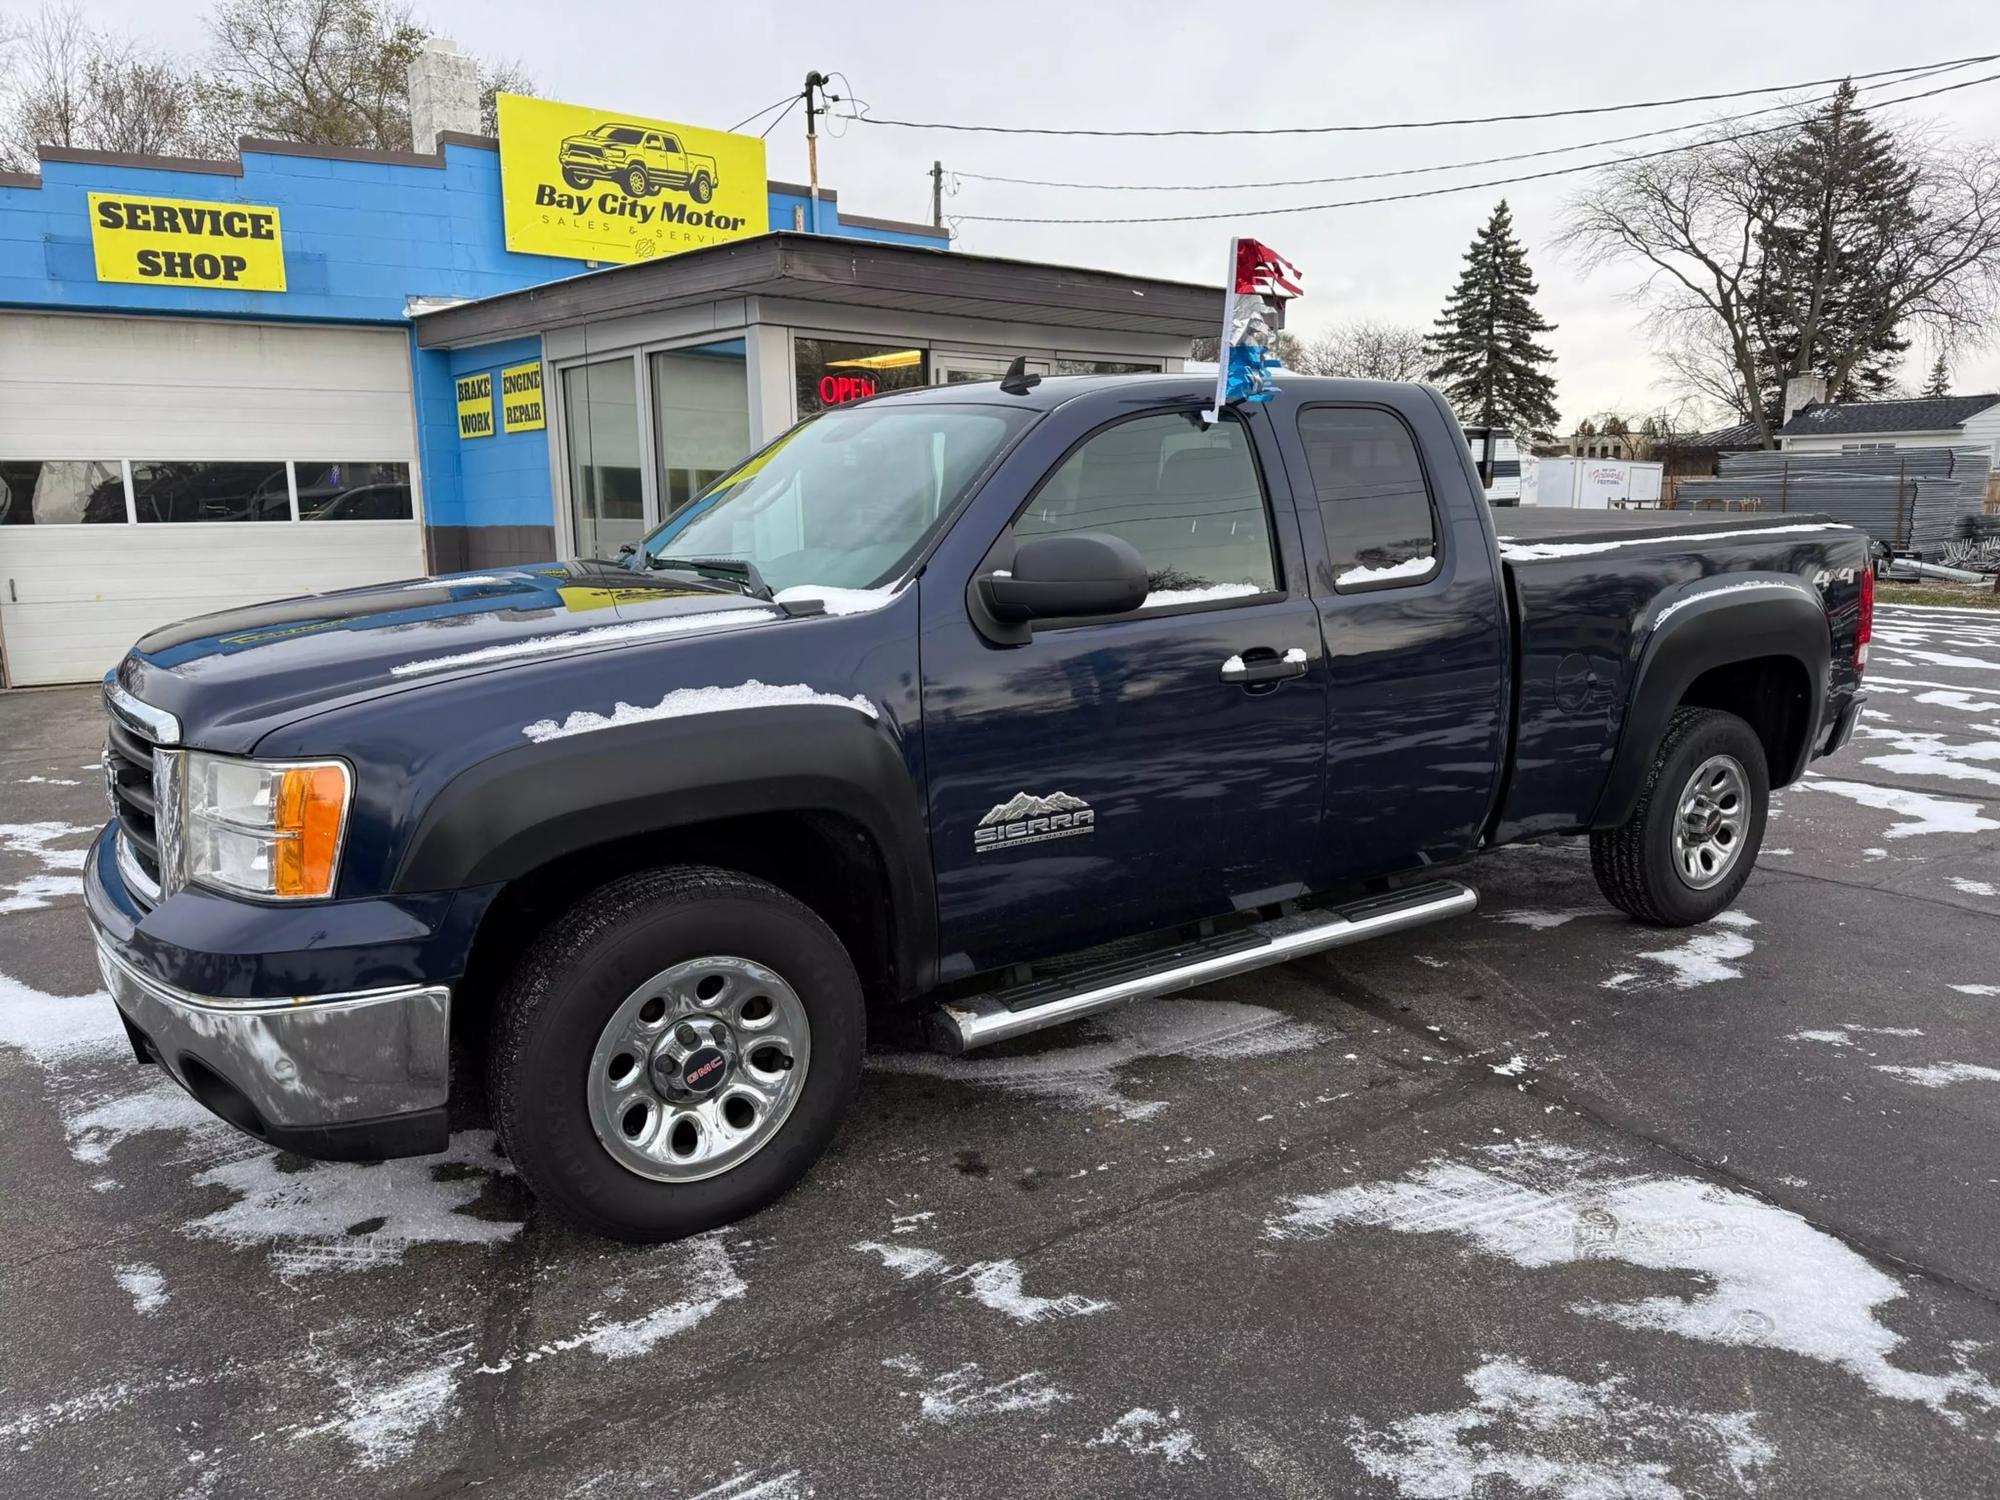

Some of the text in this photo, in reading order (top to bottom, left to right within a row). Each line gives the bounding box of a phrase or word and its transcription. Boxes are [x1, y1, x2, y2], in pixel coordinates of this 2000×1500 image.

[98, 201, 275, 240] SERVICE
[535, 184, 746, 231] Bay City Motor
[542, 215, 610, 231] SALES
[629, 226, 638, 234] &
[136, 249, 247, 281] SHOP
[457, 377, 490, 402] BRAKE
[503, 370, 540, 395] ENGINE
[820, 375, 877, 403] OPEN
[460, 411, 491, 434] WORK
[506, 402, 542, 425] REPAIR
[974, 809, 1095, 844] SIERRA
[686, 1055, 723, 1085] GMC
